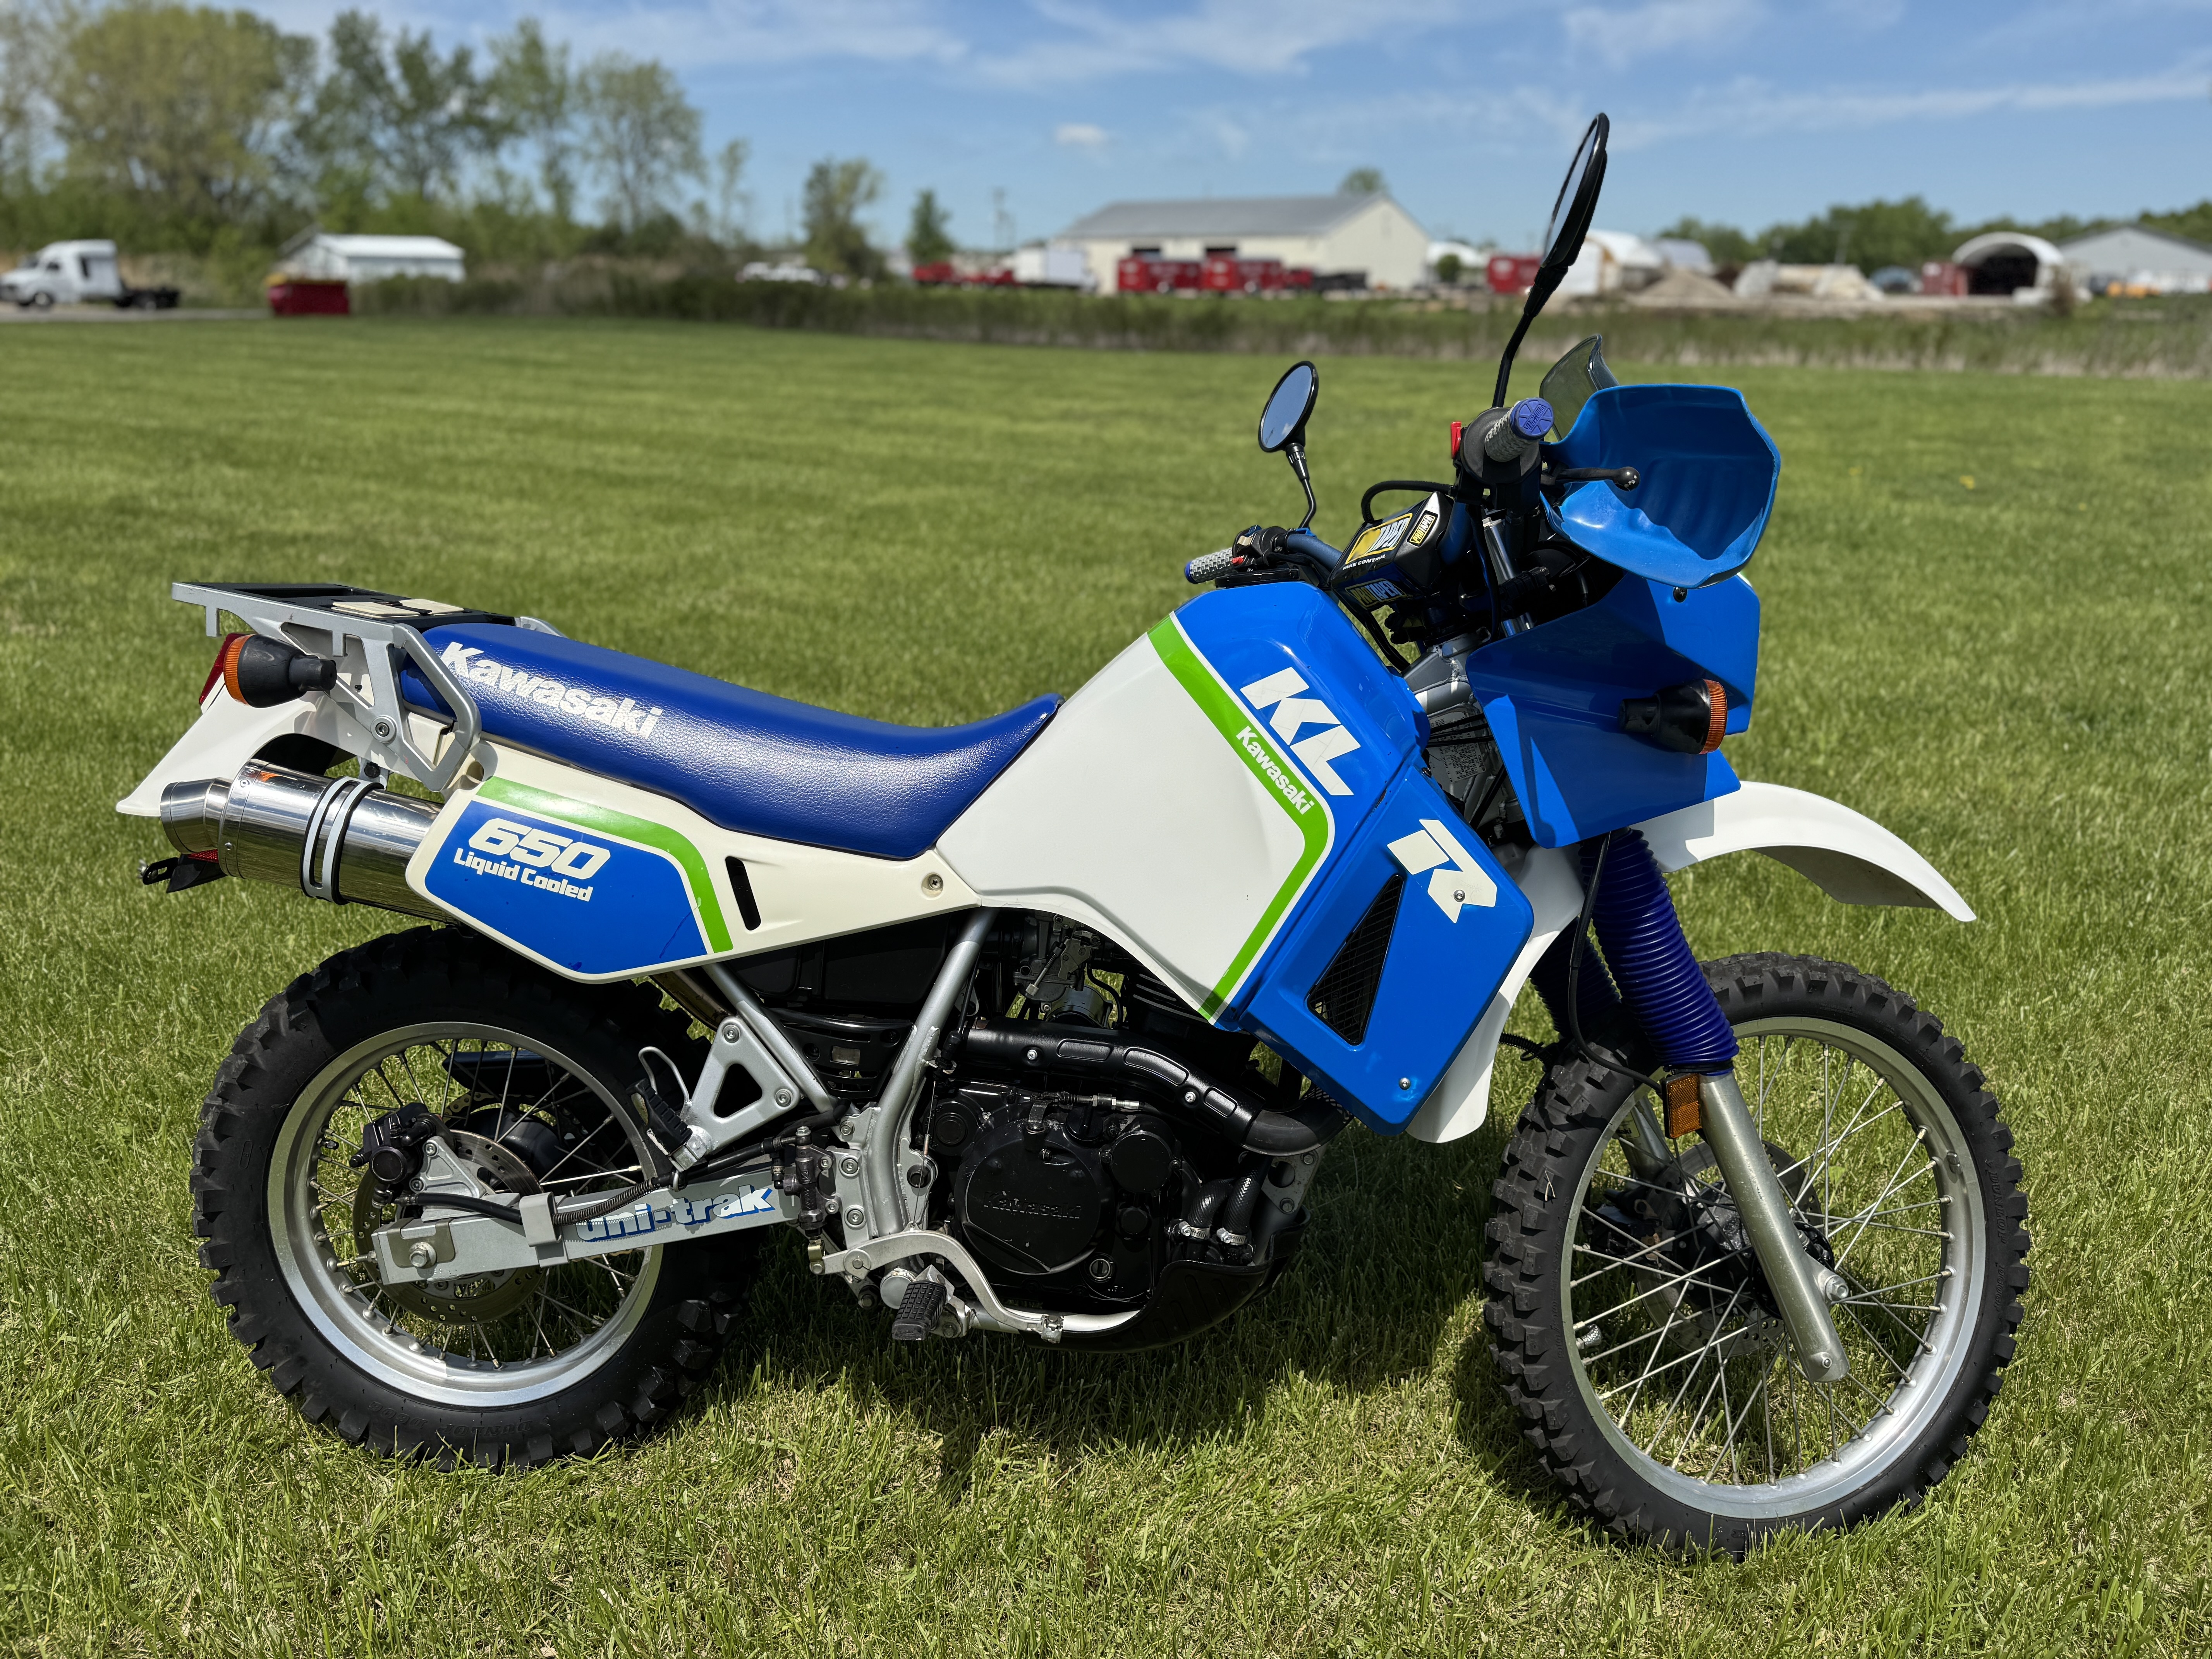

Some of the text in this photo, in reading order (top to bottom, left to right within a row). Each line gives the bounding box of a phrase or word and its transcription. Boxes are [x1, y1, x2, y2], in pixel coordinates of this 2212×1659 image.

[1412, 515, 1434, 543] PROTAPER
[1350, 580, 1403, 604] PROTAPER
[440, 641, 663, 739] Kawasaki
[1240, 667, 1361, 796] KL
[1236, 726, 1314, 815] Kawasaki
[453, 847, 594, 902] Liquid Cooled
[468, 818, 611, 880] 650
[575, 1184, 776, 1242] uni-trak
[983, 1190, 1082, 1219] Kawasaki
[1989, 1172, 2007, 1245] DUNLOP
[368, 1401, 533, 1437] DUNLOP D606
